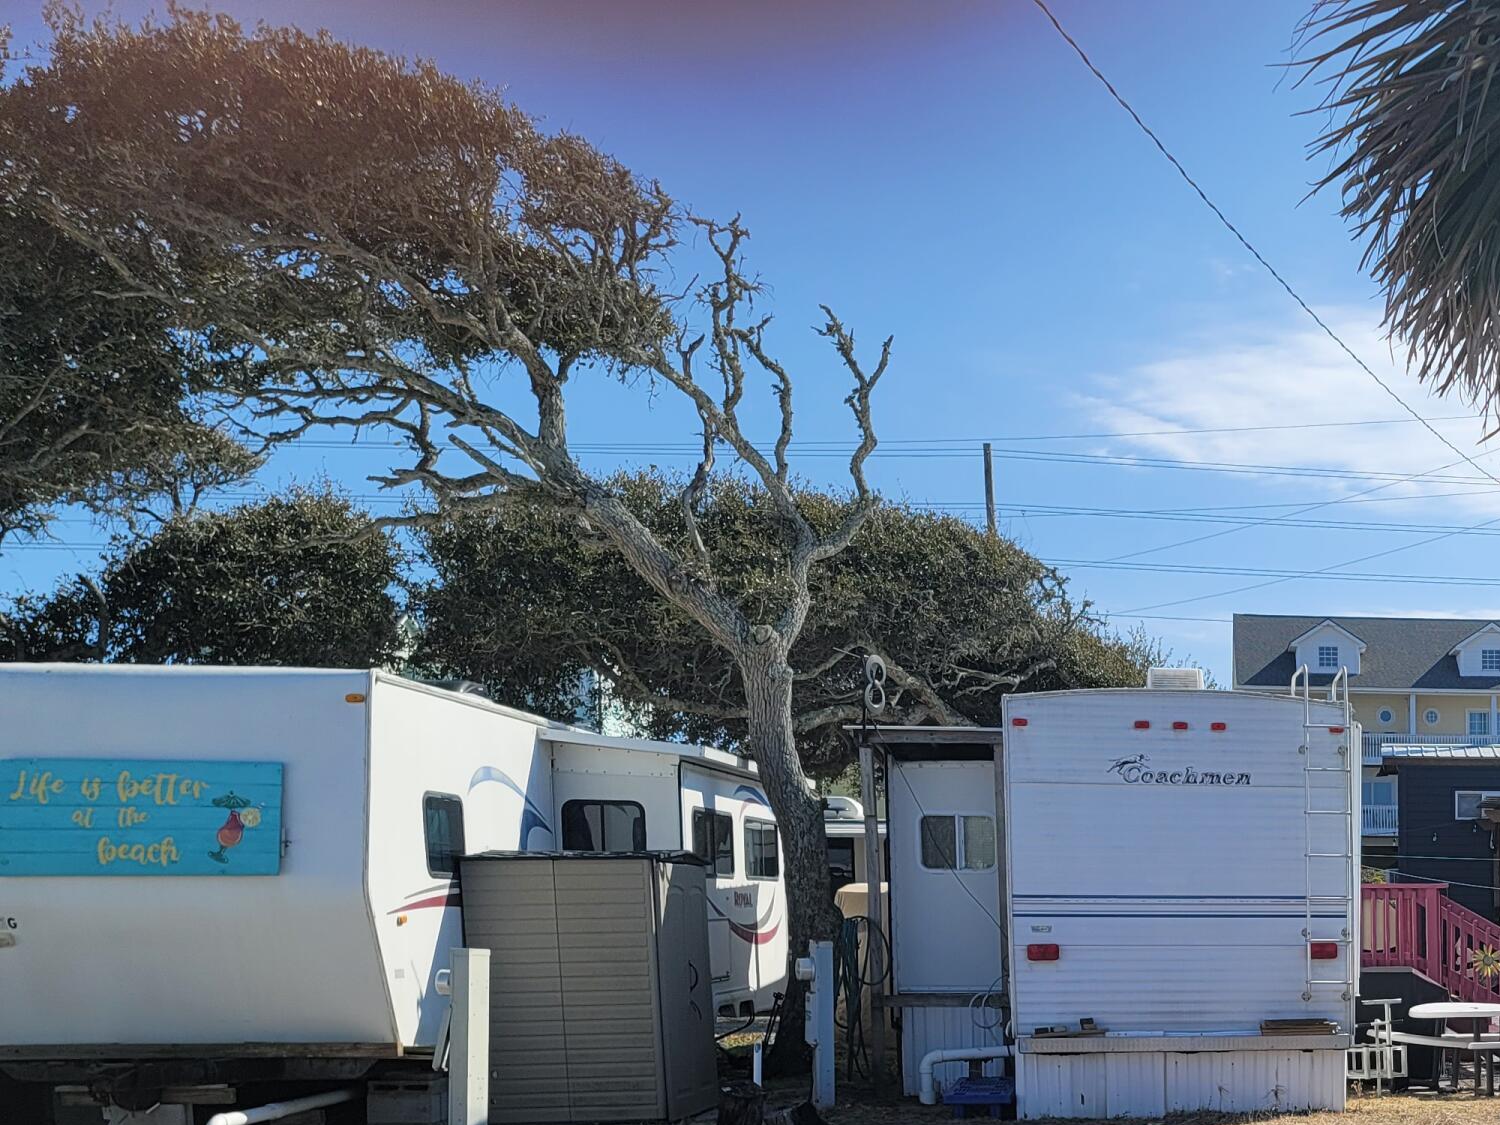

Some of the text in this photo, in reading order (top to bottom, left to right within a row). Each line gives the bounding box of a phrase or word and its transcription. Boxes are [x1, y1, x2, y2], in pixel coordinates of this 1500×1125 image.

[9, 769, 212, 806] Life is better
[1123, 766, 1252, 785] Coachmen
[71, 806, 151, 829] at the
[97, 836, 181, 867] beach
